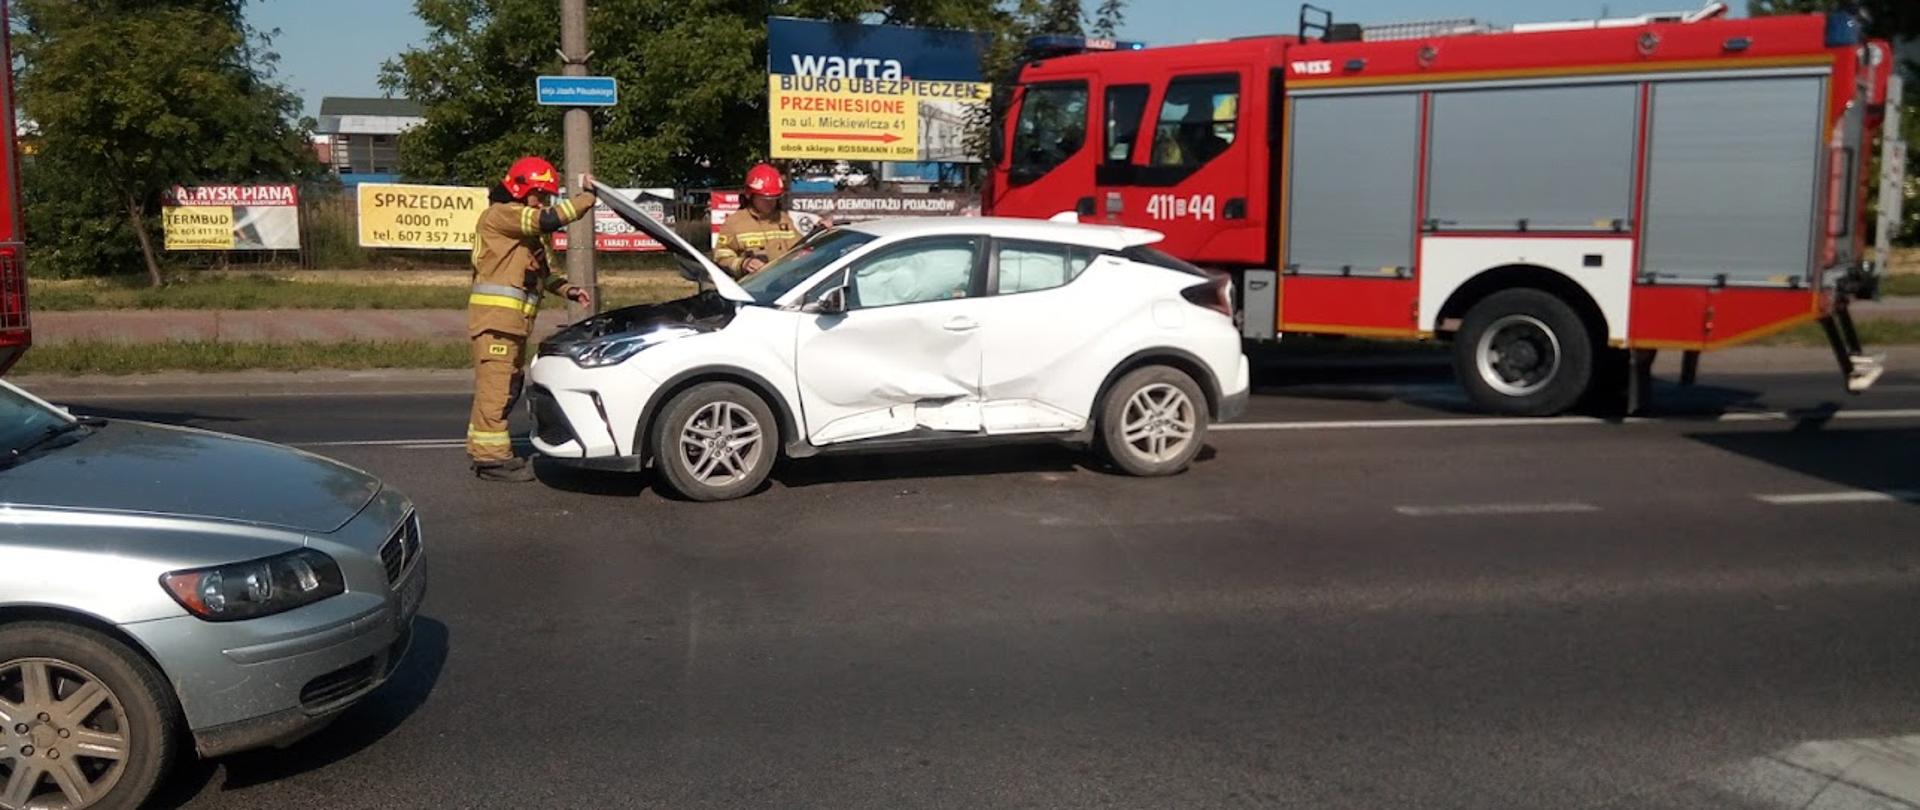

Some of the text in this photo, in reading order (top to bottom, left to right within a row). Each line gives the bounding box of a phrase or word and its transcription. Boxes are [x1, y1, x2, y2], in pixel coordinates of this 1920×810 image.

[780, 75, 841, 93] BIURO
[780, 96, 905, 114] PRZENIESIONE
[781, 116, 906, 131] na ul. Mickiewicza 41
[781, 144, 802, 153] obok
[806, 145, 835, 155] sklepu
[837, 145, 889, 154] ROSSMANN
[242, 185, 294, 204] PIANĄ
[374, 192, 474, 211] SPRZEDAM
[791, 197, 834, 211] STACJA
[902, 197, 957, 211] POJAZDÓW
[167, 213, 229, 225] TERMBUD
[395, 213, 431, 227] 4000
[373, 229, 476, 243] tel. 607 357 718
